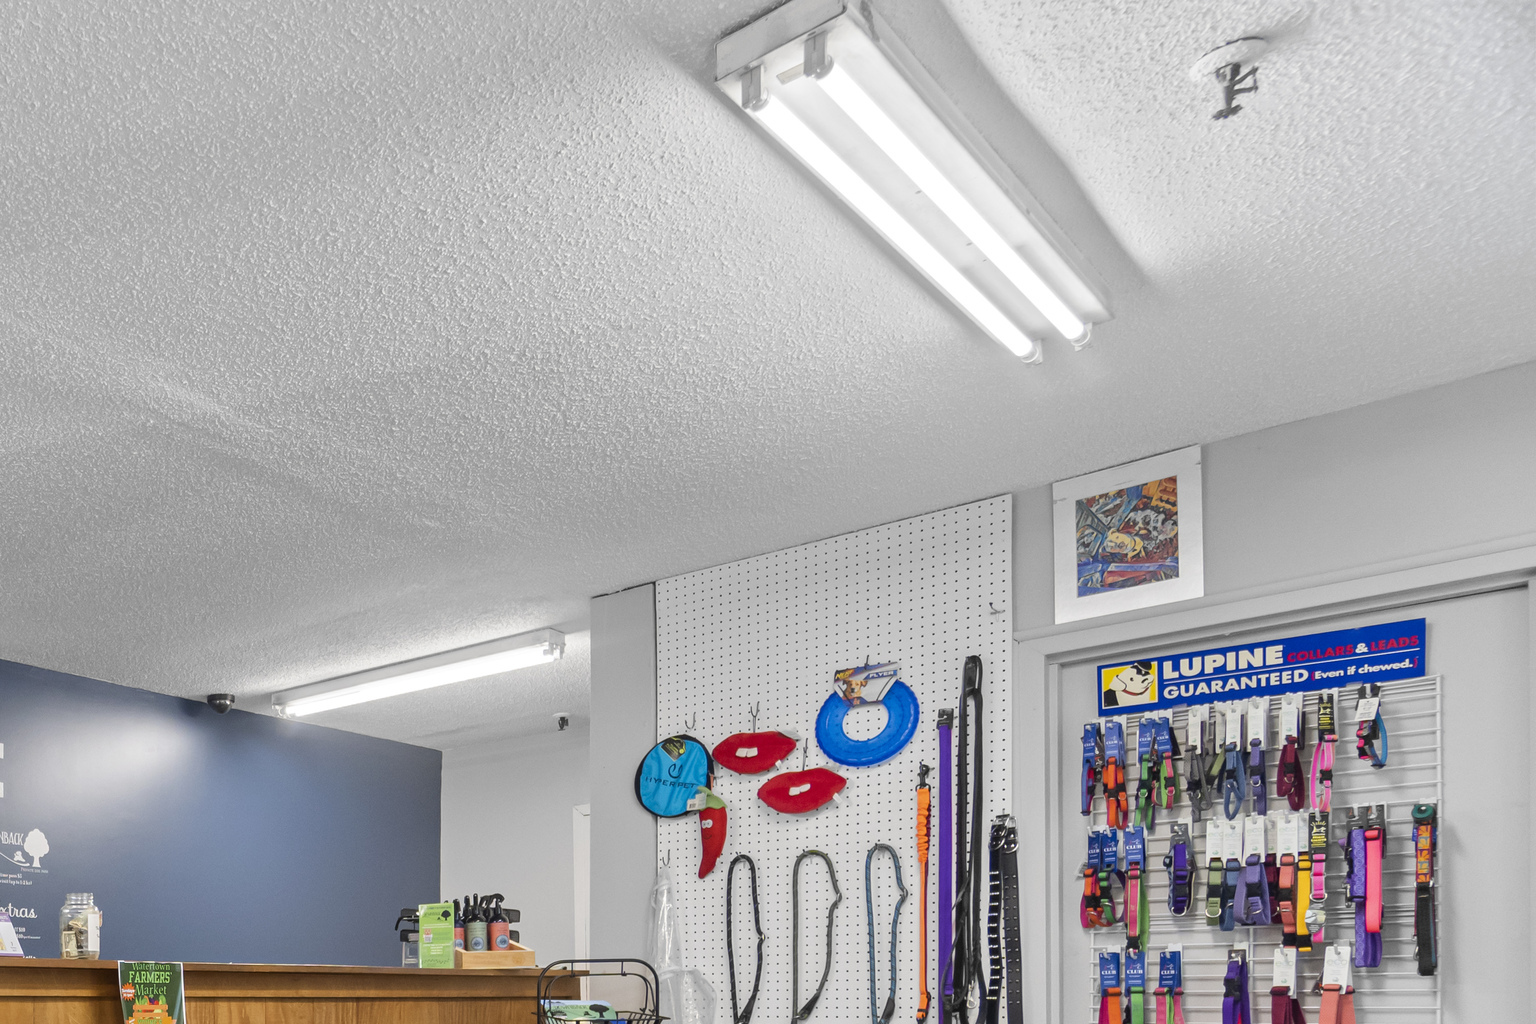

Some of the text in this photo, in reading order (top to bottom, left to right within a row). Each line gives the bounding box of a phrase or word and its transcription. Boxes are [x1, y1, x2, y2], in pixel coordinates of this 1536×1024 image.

[1162, 636, 1419, 680] LUPINE COLLARS & LEADS
[1163, 658, 1418, 699] GUARANTEED (Even if chewed.)
[646, 776, 676, 787] HYPER
[135, 984, 167, 996] Market
